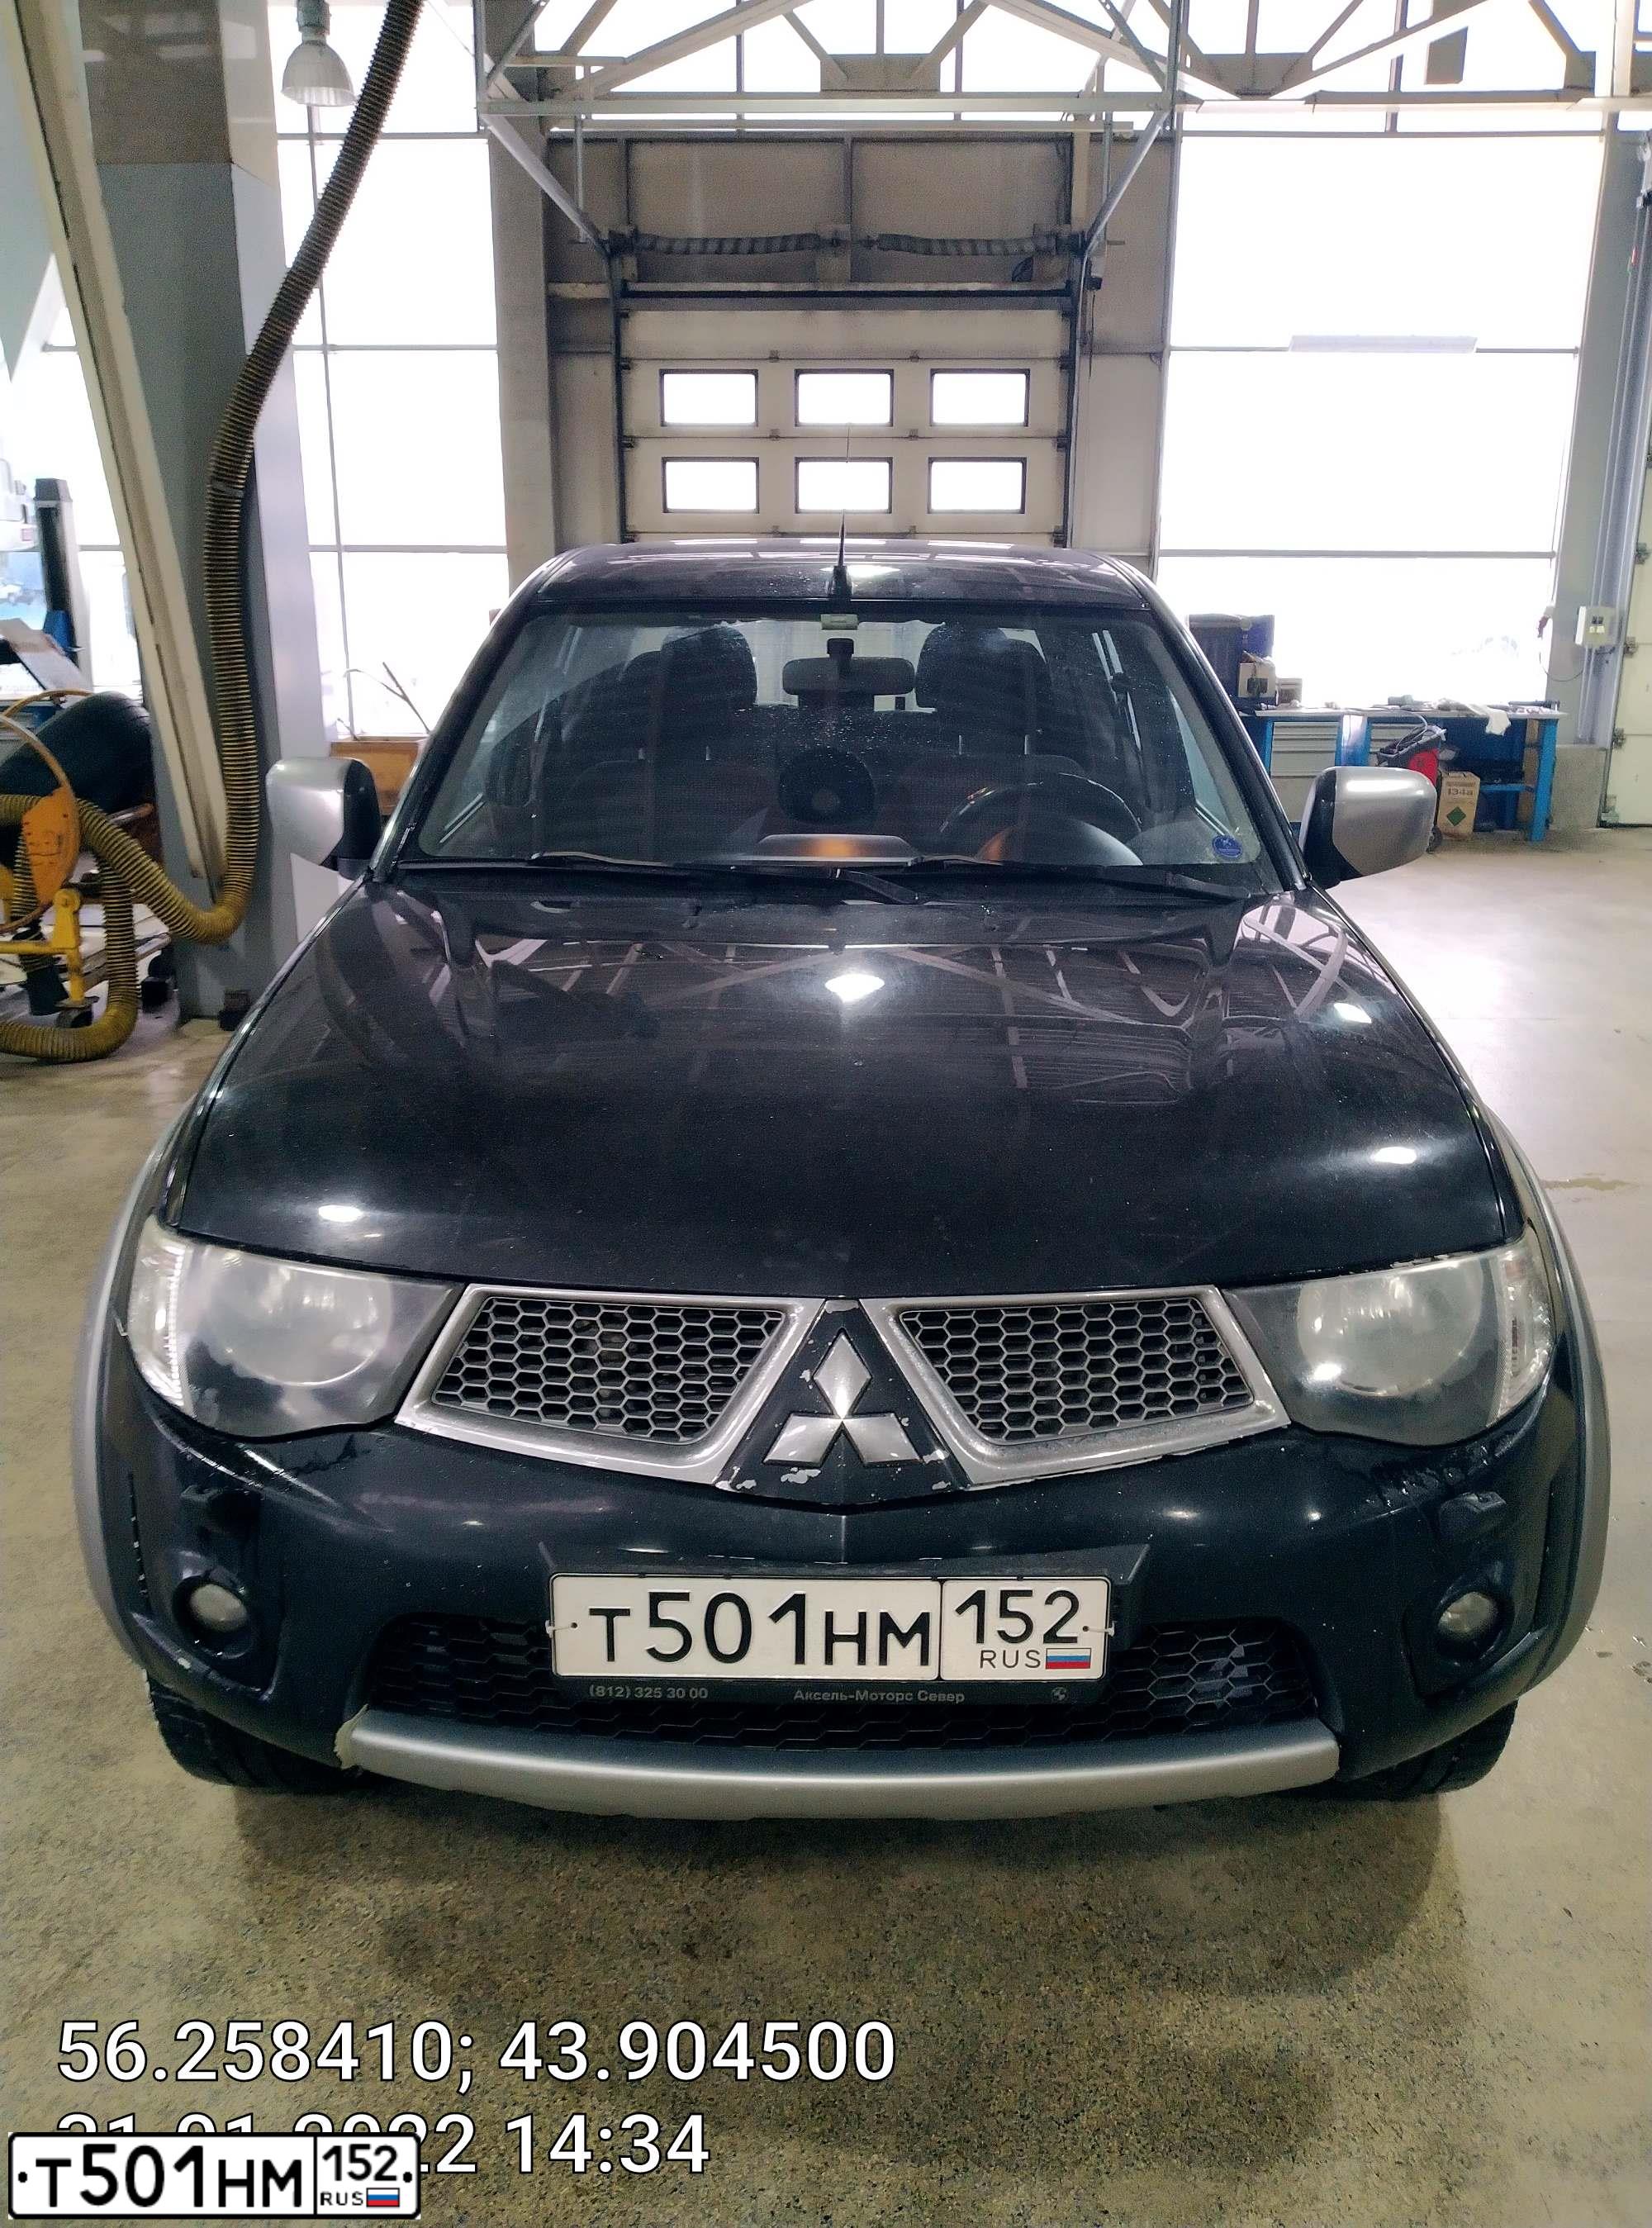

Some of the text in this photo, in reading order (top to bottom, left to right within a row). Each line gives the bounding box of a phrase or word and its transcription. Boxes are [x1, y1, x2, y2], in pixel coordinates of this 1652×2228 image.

[955, 1589, 1080, 1644] 152
[588, 1591, 931, 1666] Т501НМ
[980, 1650, 1041, 1669] RUS
[589, 1684, 709, 1698] (812) 325 30 00
[794, 1689, 965, 1703] Аксель-Моторс Север
